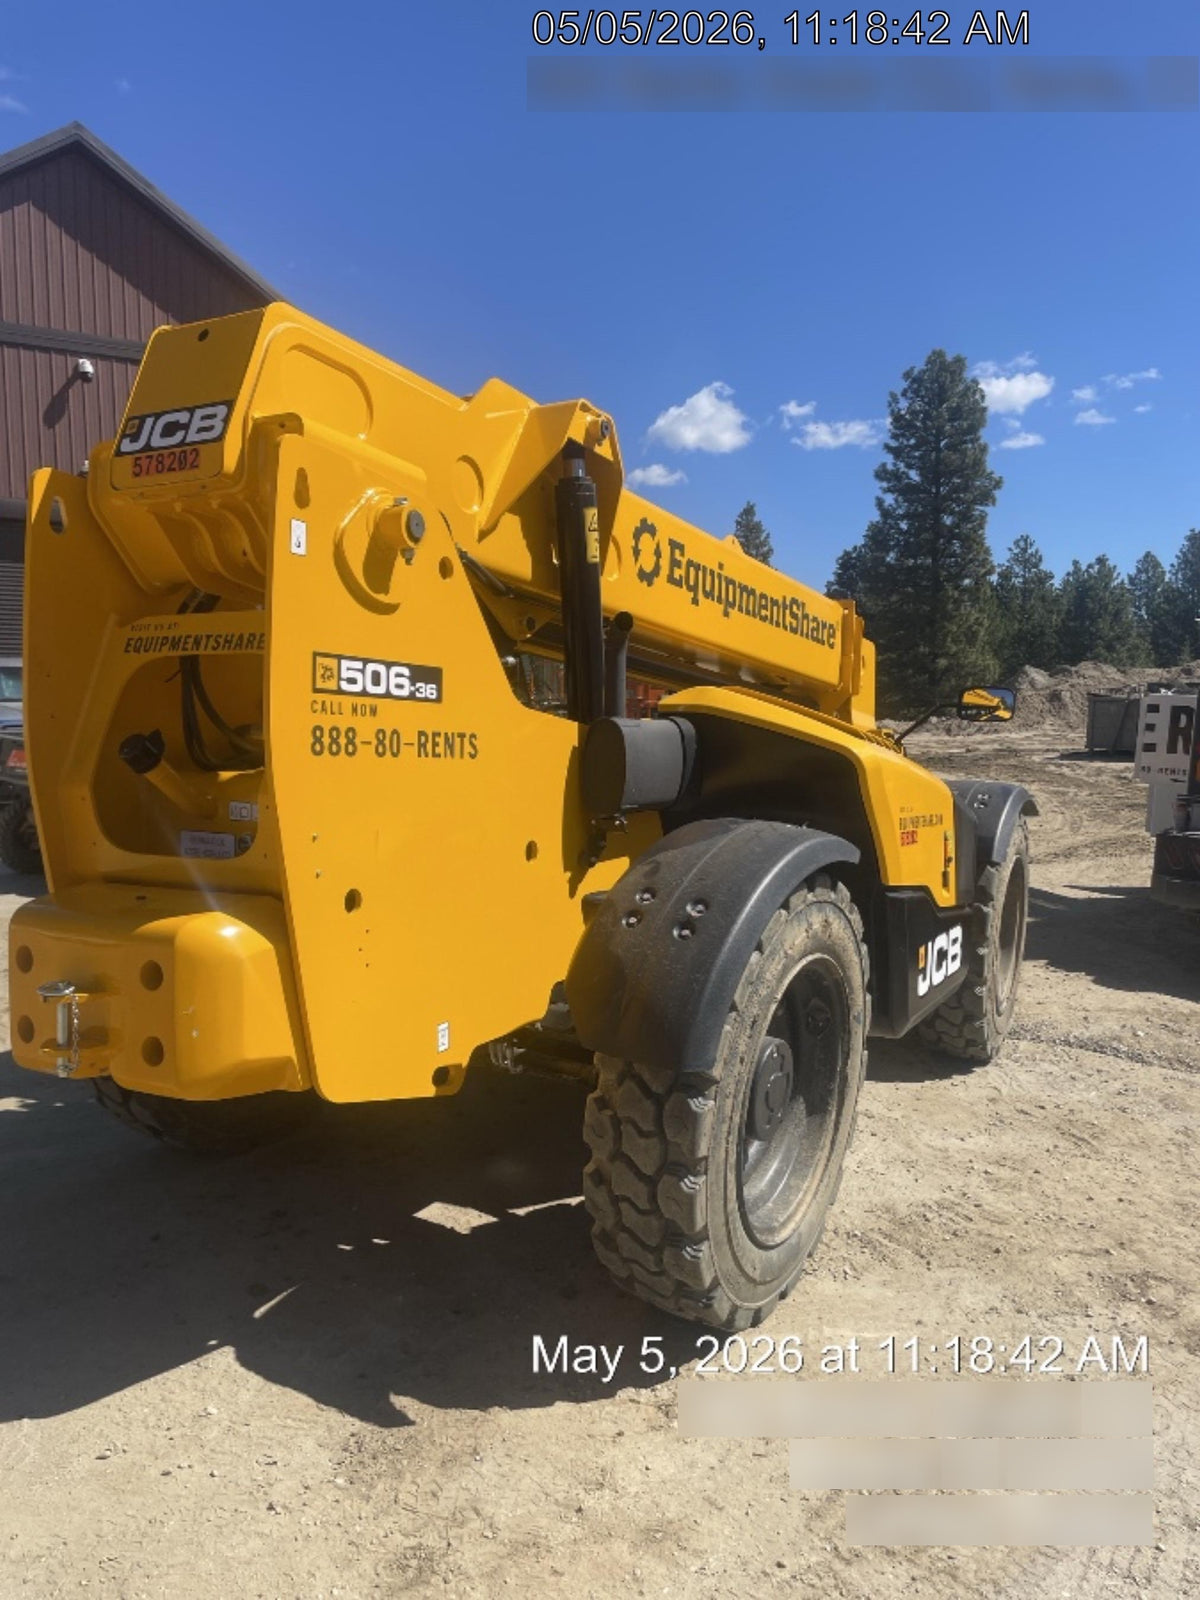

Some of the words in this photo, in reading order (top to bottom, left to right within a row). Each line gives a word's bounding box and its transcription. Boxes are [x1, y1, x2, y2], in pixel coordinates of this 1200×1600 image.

[119, 404, 228, 453] JCB
[132, 448, 200, 478] 578202
[666, 537, 837, 650] EquipmentShare
[310, 699, 345, 716] CALL
[351, 703, 379, 717] NOW
[310, 724, 479, 760] 888-80-RENTS
[917, 925, 963, 997] JCB
